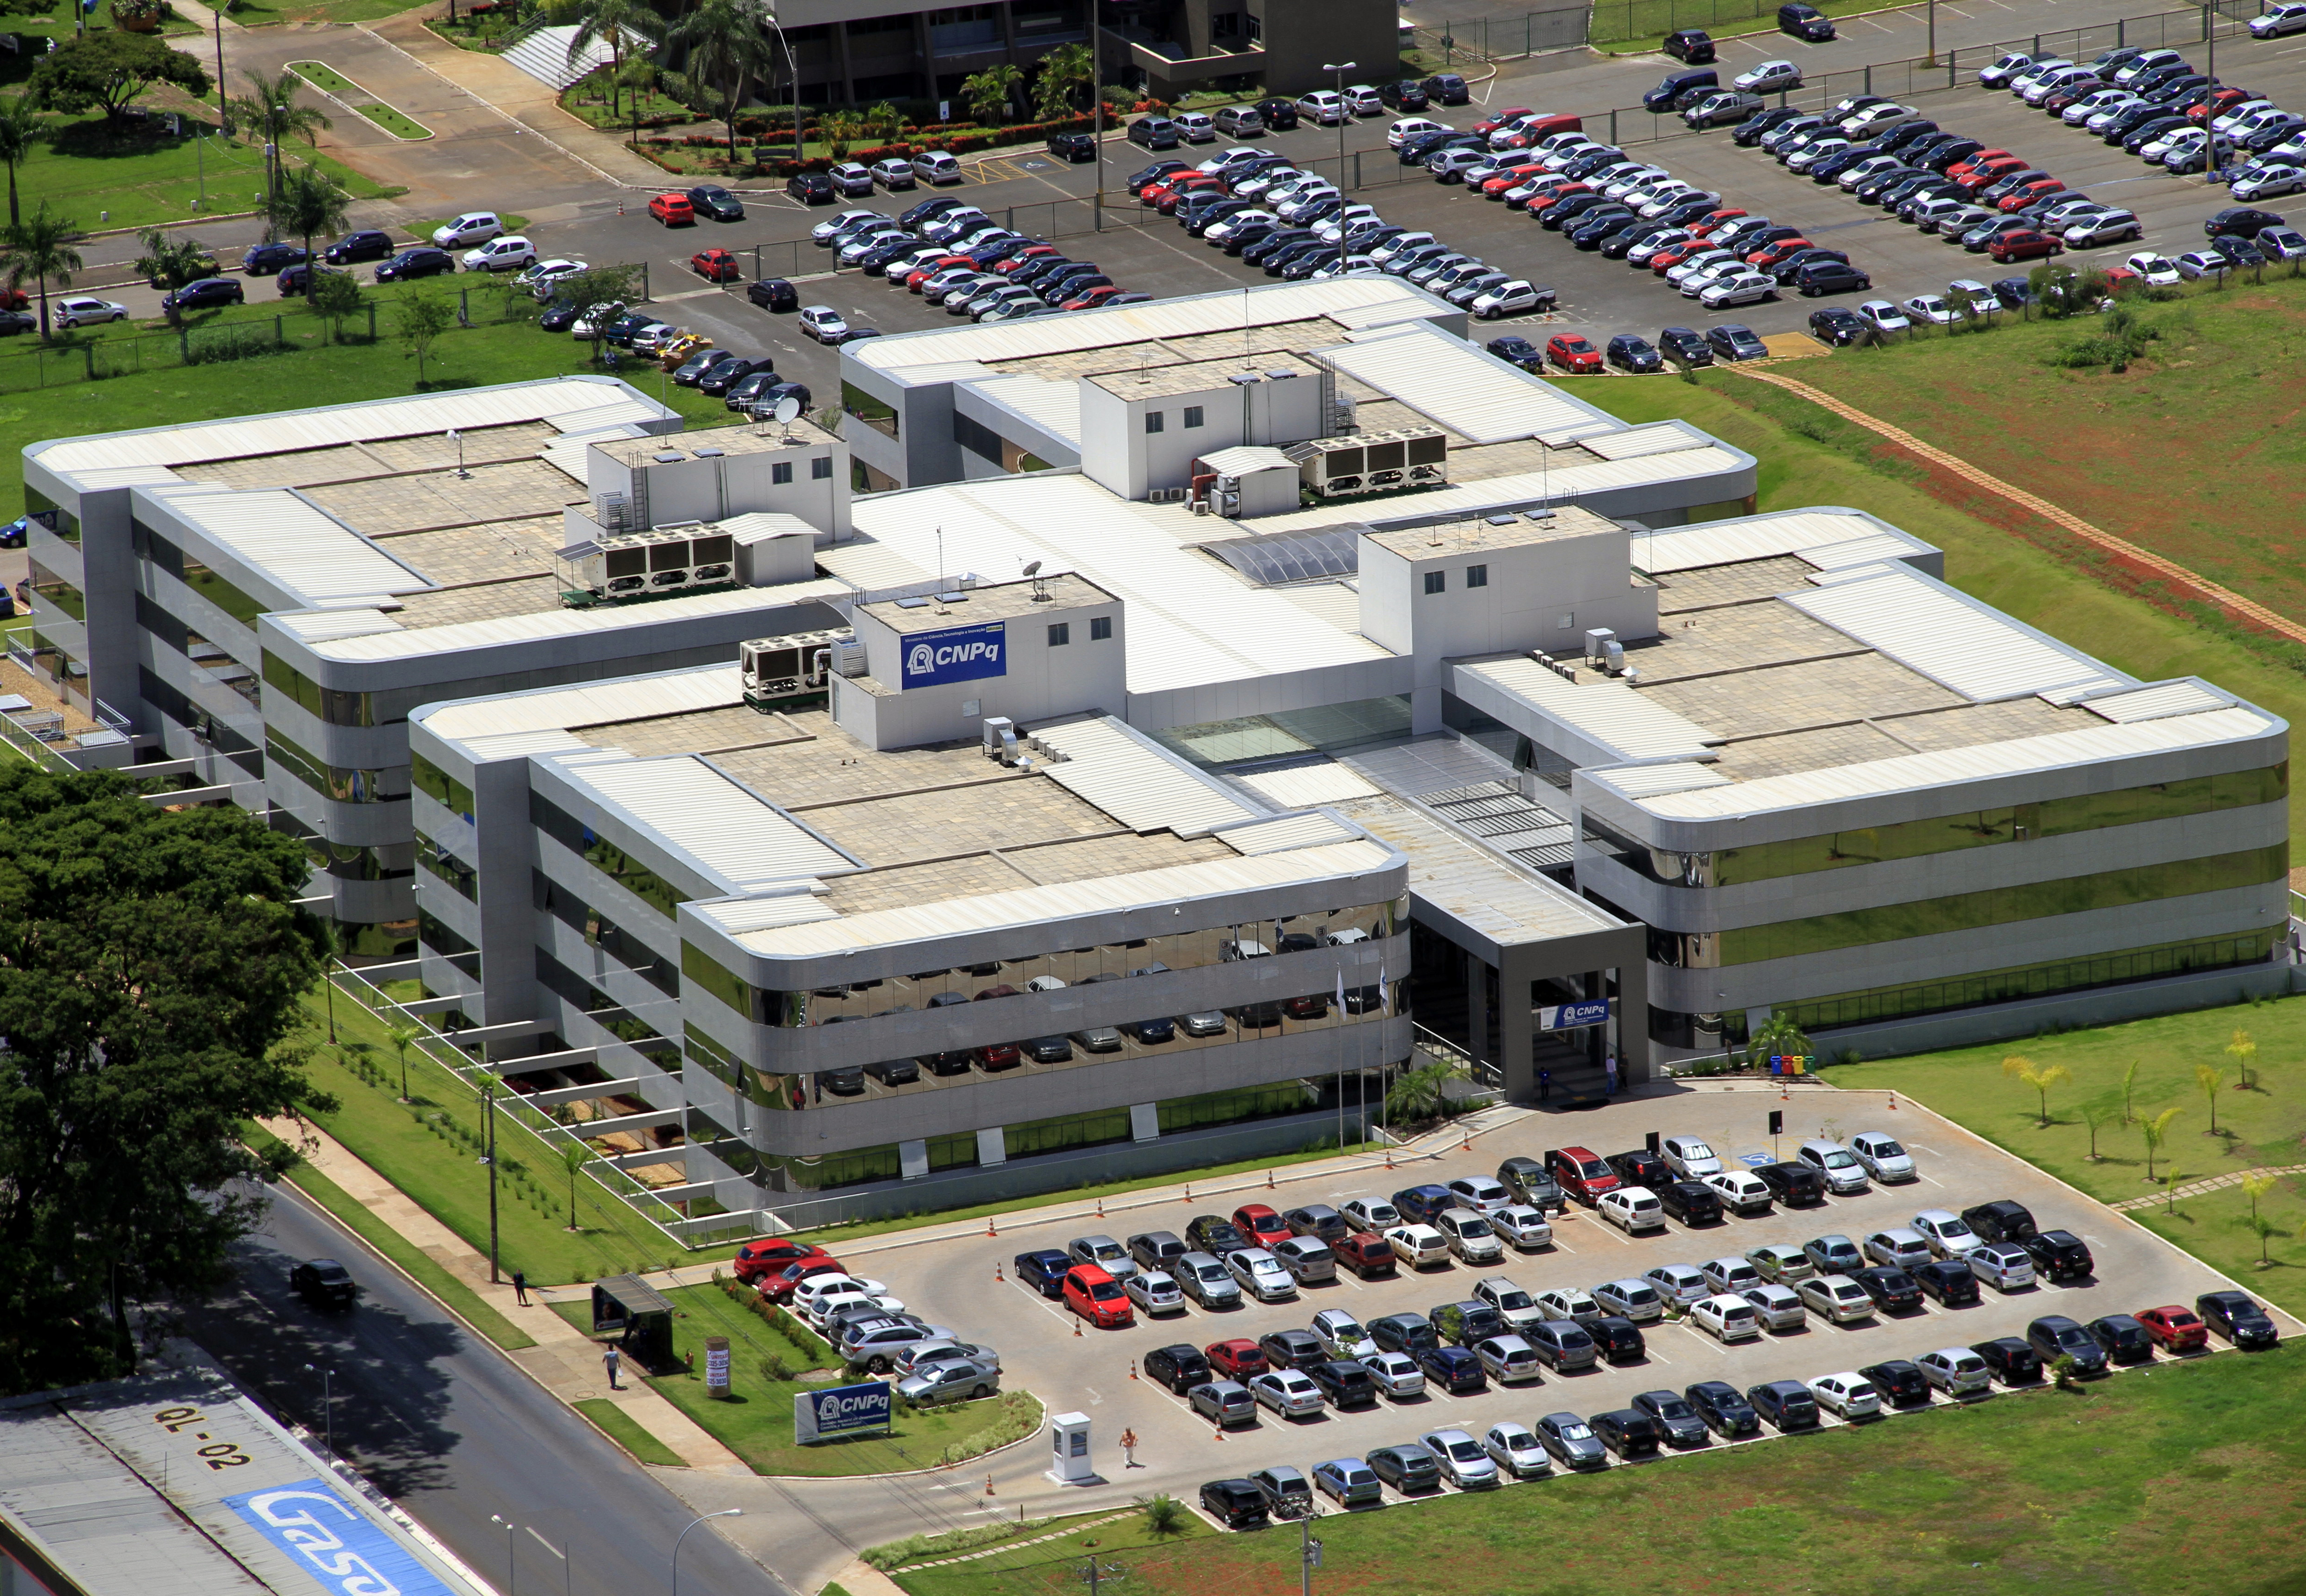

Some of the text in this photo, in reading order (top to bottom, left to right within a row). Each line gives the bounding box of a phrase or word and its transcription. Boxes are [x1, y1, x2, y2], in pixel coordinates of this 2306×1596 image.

[936, 642, 999, 665] CNPq
[1576, 1005, 1605, 1016] CNPq
[840, 1394, 889, 1412] CNPq
[248, 1490, 401, 1596] Gaso
